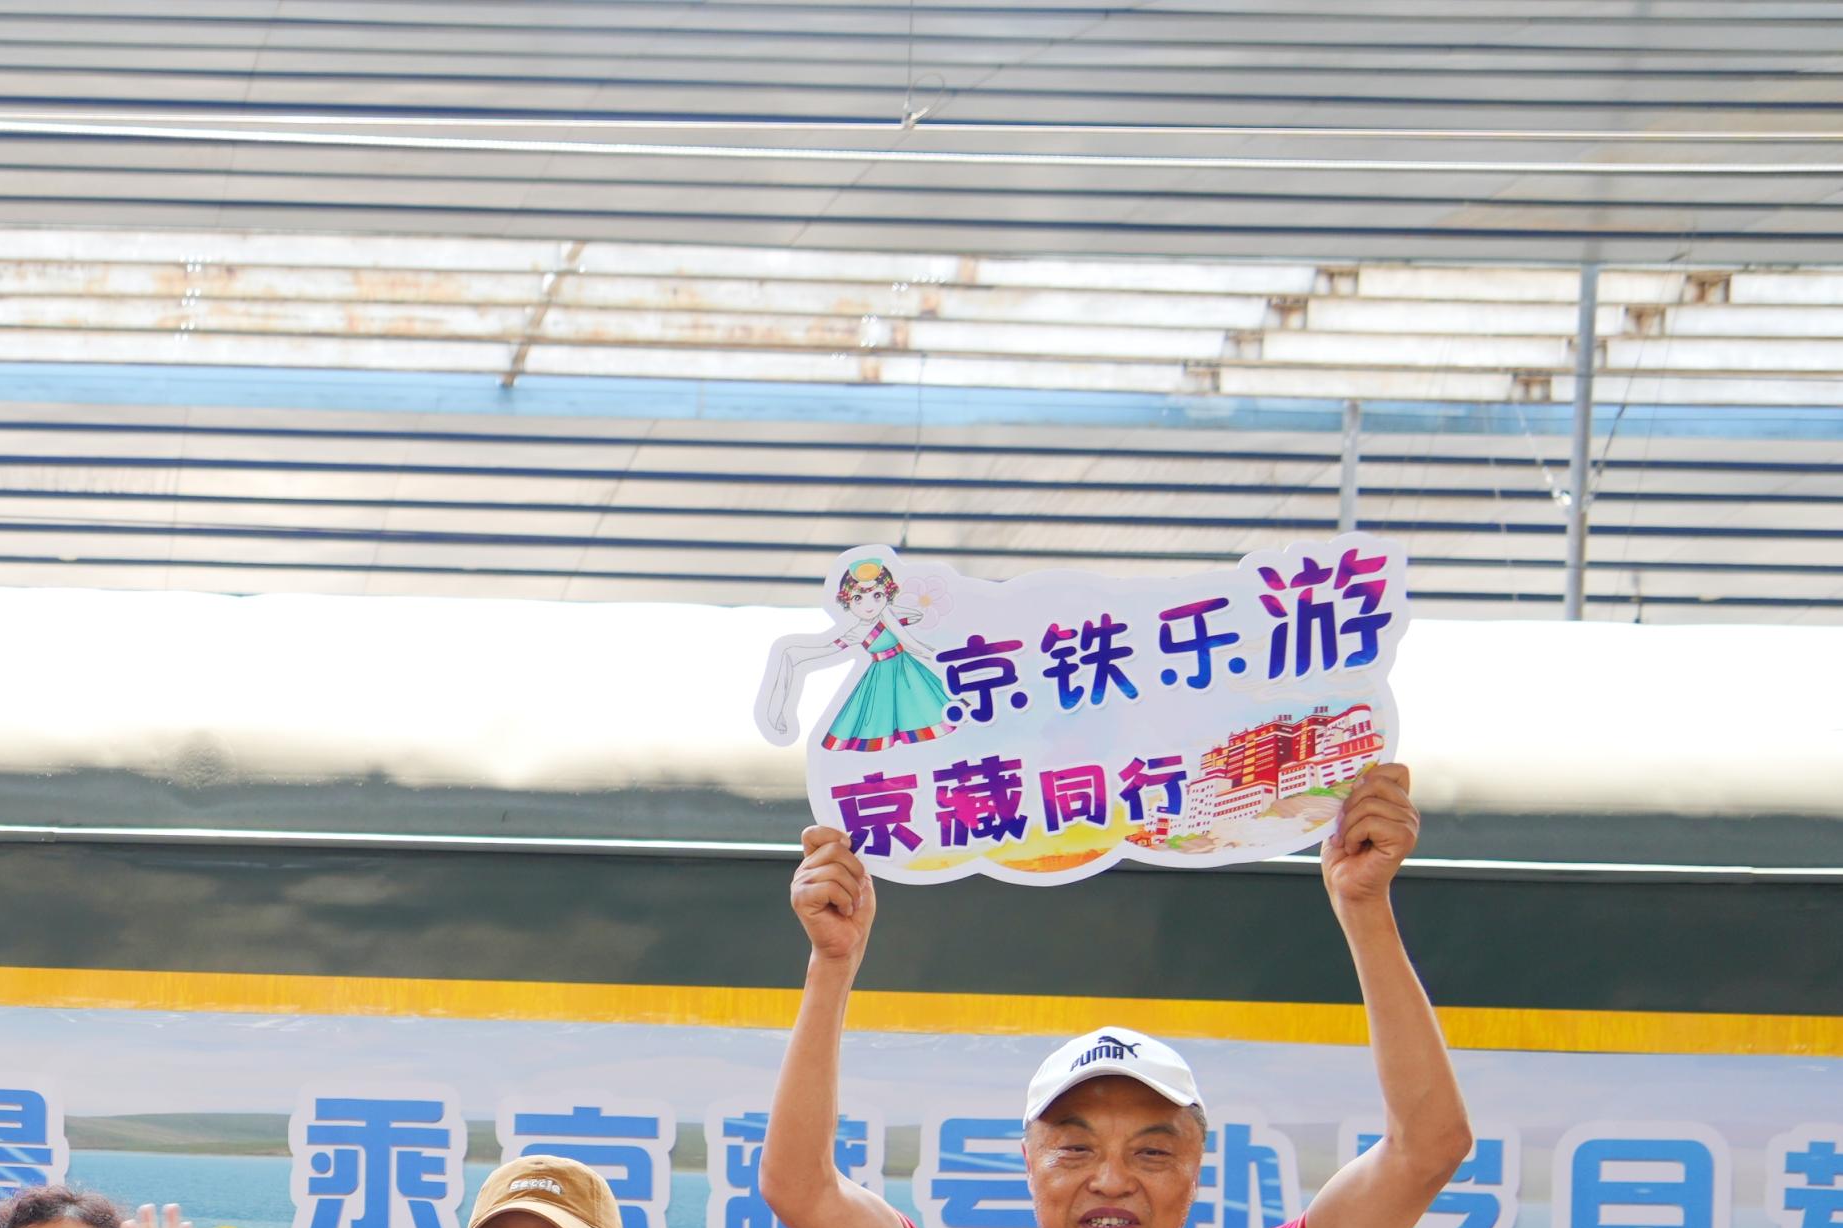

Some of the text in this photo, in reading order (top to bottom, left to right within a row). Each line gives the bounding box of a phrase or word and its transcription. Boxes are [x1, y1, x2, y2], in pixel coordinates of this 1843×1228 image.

[935, 547, 1393, 723] 京铁乐游
[830, 754, 1189, 858] 京藏同行
[1069, 1044, 1125, 1073] PUMA
